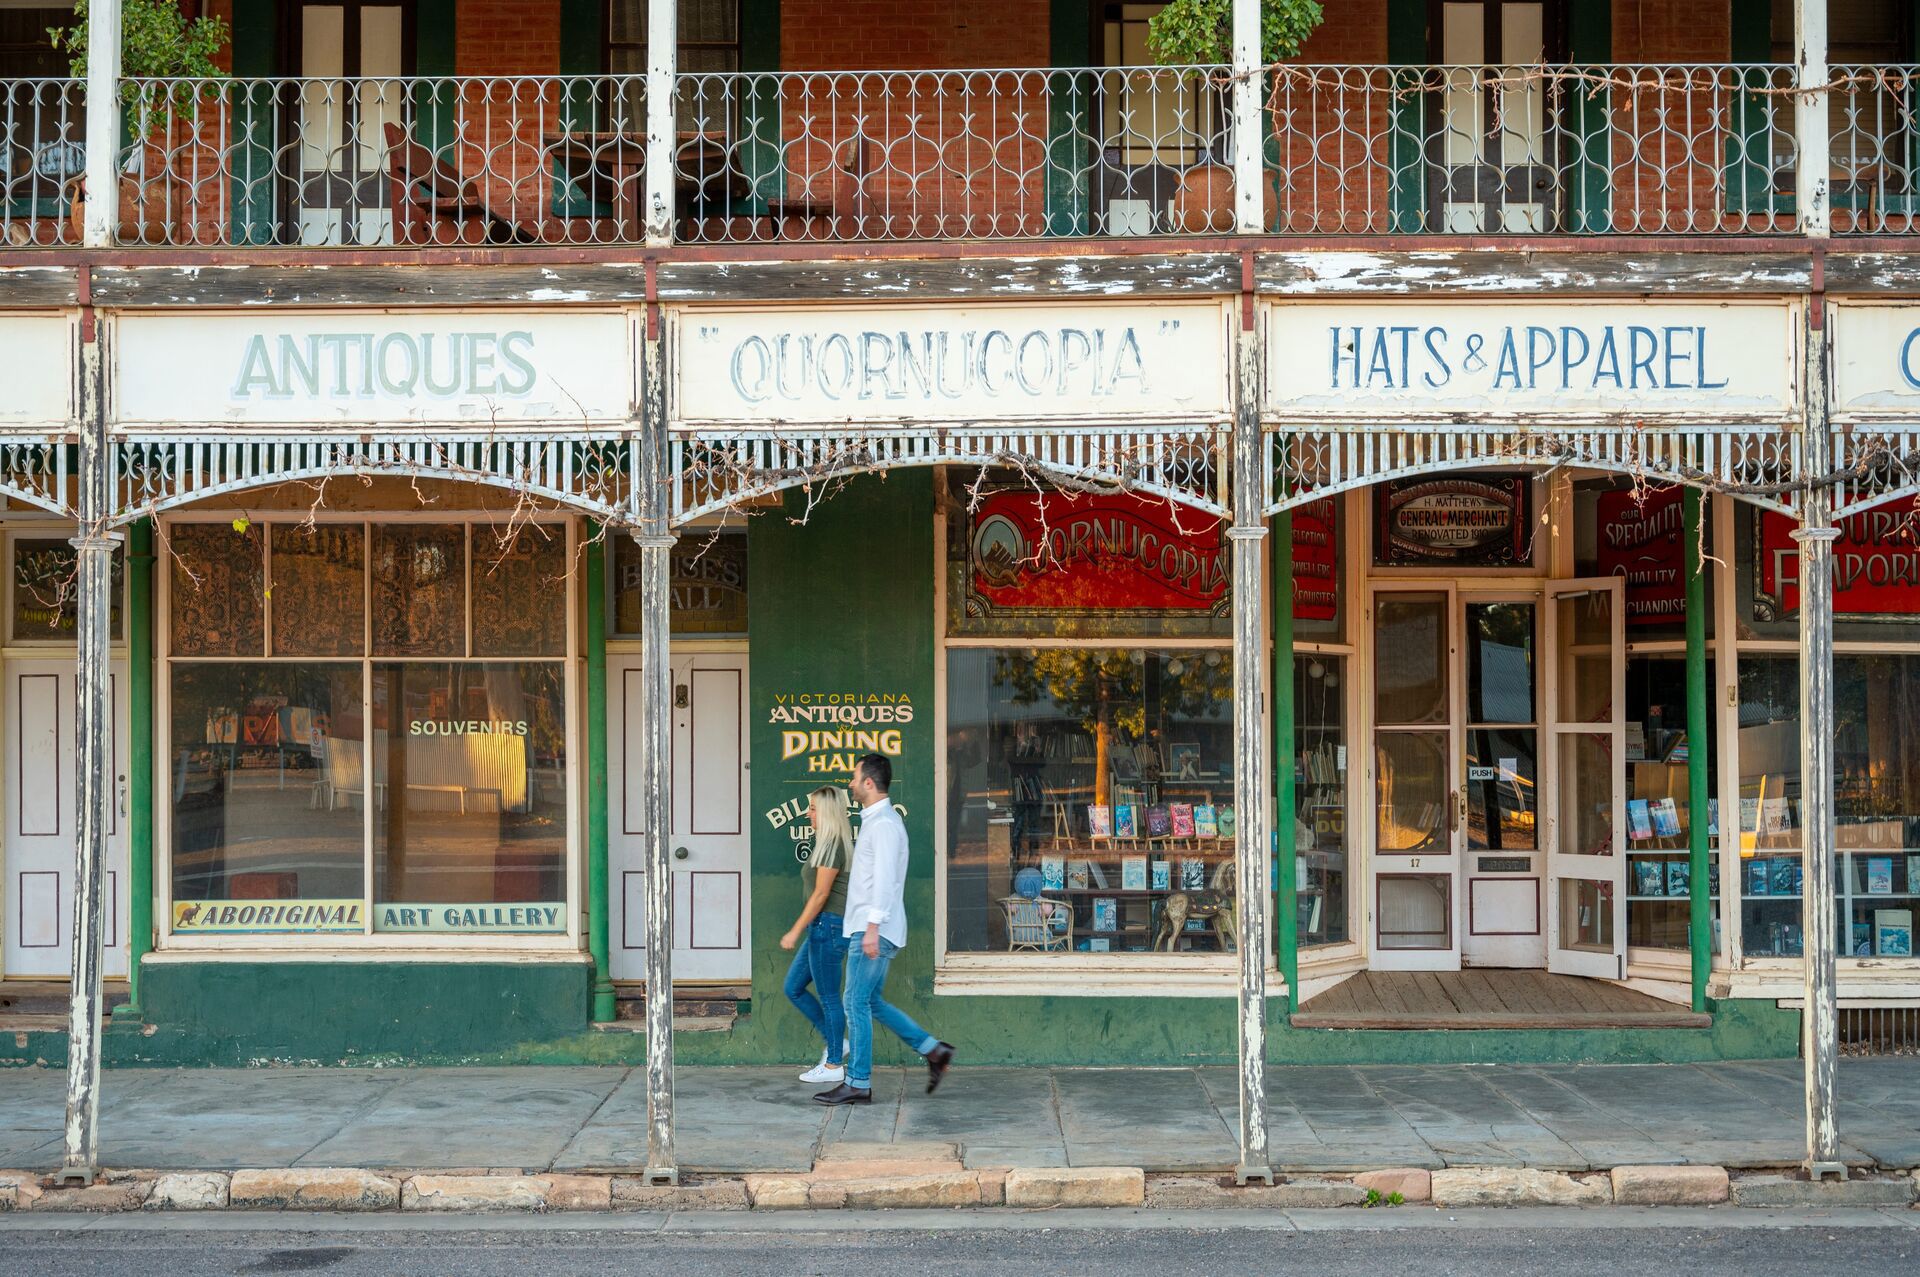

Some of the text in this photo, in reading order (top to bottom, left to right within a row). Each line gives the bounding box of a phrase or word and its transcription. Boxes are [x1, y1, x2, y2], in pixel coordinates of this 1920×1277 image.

[231, 331, 537, 399] ANTIQUES
[1328, 326, 1730, 391] HATS & APPAREL
[1435, 497, 1482, 508] MATTHEWS
[1400, 510, 1507, 527] GENERAL MERCHANT
[1620, 509, 1639, 520] OUR
[1292, 529, 1328, 546] ELECTION
[1411, 528, 1469, 540] RENOVATED
[1292, 561, 1331, 577] AVELLERS
[1773, 550, 1920, 622] EPORI
[669, 586, 724, 610] ALL
[775, 693, 911, 704] VICTORIANA
[768, 705, 914, 726] ANTIQUES
[409, 720, 528, 736] SOUVENIRS
[781, 729, 902, 760] DINING
[808, 753, 864, 773] HAL
[1471, 769, 1492, 778] PUSH
[1410, 858, 1420, 868] 17
[200, 905, 361, 926] ABORIGINAL
[383, 908, 559, 927] ART GALLERY
